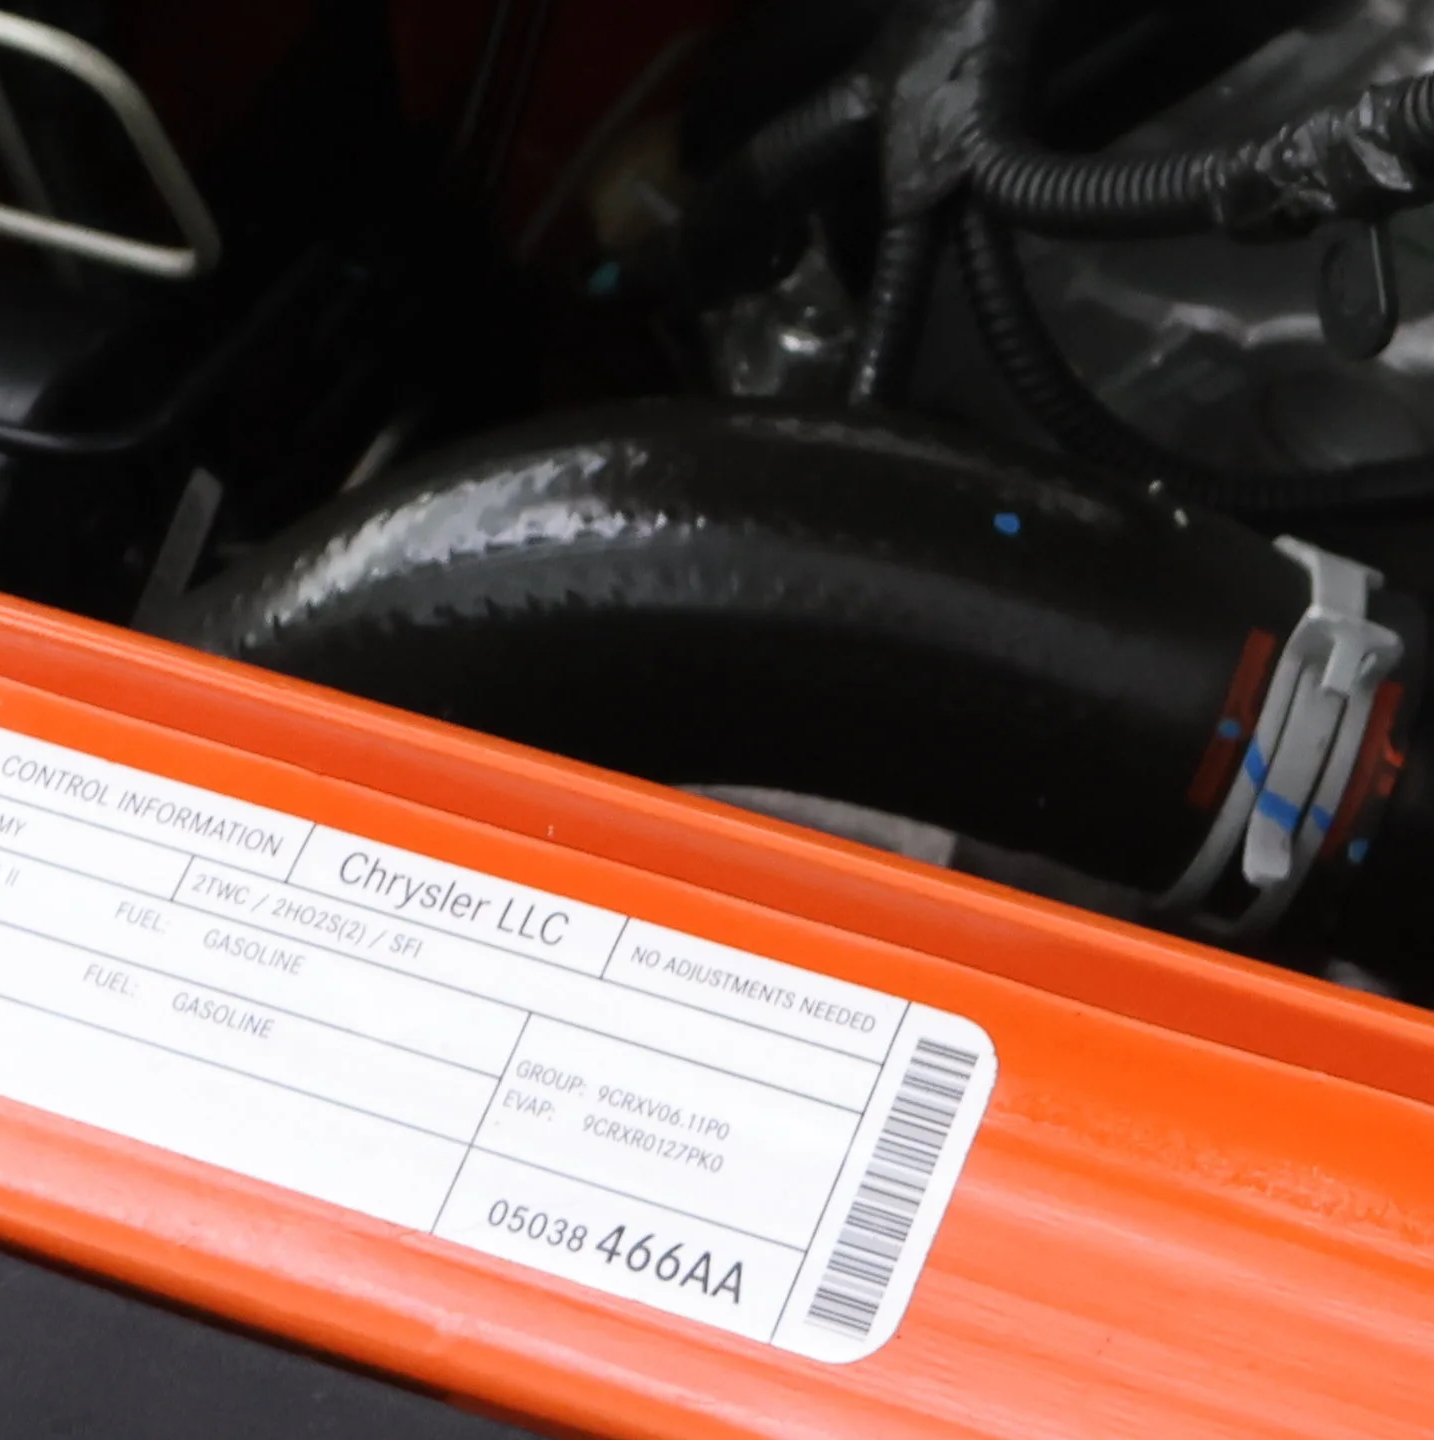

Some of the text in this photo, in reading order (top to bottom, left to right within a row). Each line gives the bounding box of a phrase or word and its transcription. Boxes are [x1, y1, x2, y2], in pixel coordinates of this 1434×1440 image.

[2, 754, 110, 806] CONTROL
[117, 790, 285, 858] INFORMATION
[114, 901, 306, 976] FUEL: GASOLINE
[191, 874, 251, 906] 2TWC
[250, 893, 269, 913] /
[367, 929, 388, 949] /
[388, 933, 424, 959] SFI
[339, 851, 570, 947] Chrysler LLC
[81, 963, 276, 1040] FUEL: GASOLINE
[630, 946, 877, 1034] NO ADJUSTMENTS NEEDED
[502, 1088, 556, 1122] EVAP:
[516, 1059, 588, 1098] GROUP:
[487, 1199, 745, 1305] 05038 466AA
